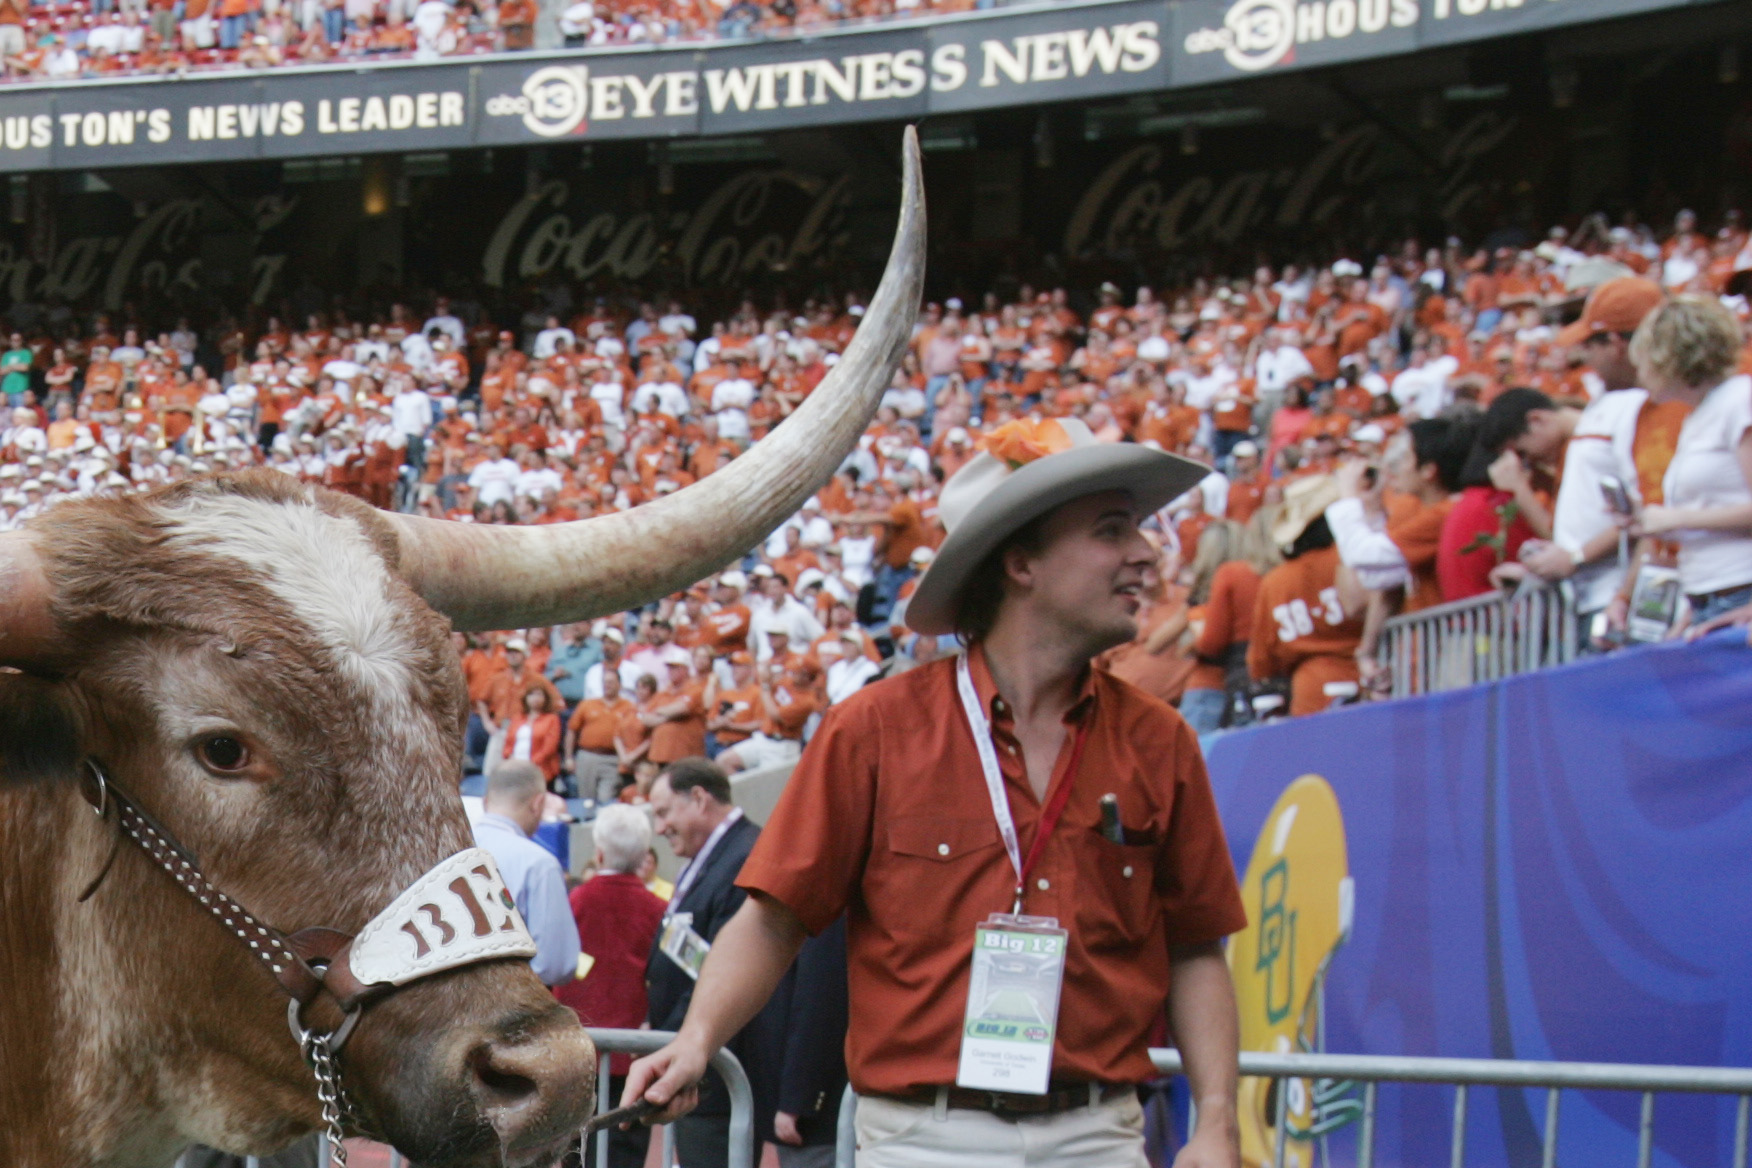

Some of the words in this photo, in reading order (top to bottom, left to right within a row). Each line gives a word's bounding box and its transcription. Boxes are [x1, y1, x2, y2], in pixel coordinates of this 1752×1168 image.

[979, 20, 1160, 87] NEWS
[188, 100, 305, 140] NEWS
[317, 91, 465, 133] LEADER
[985, 933, 1024, 953] Big
[1031, 937, 1059, 953] 12
